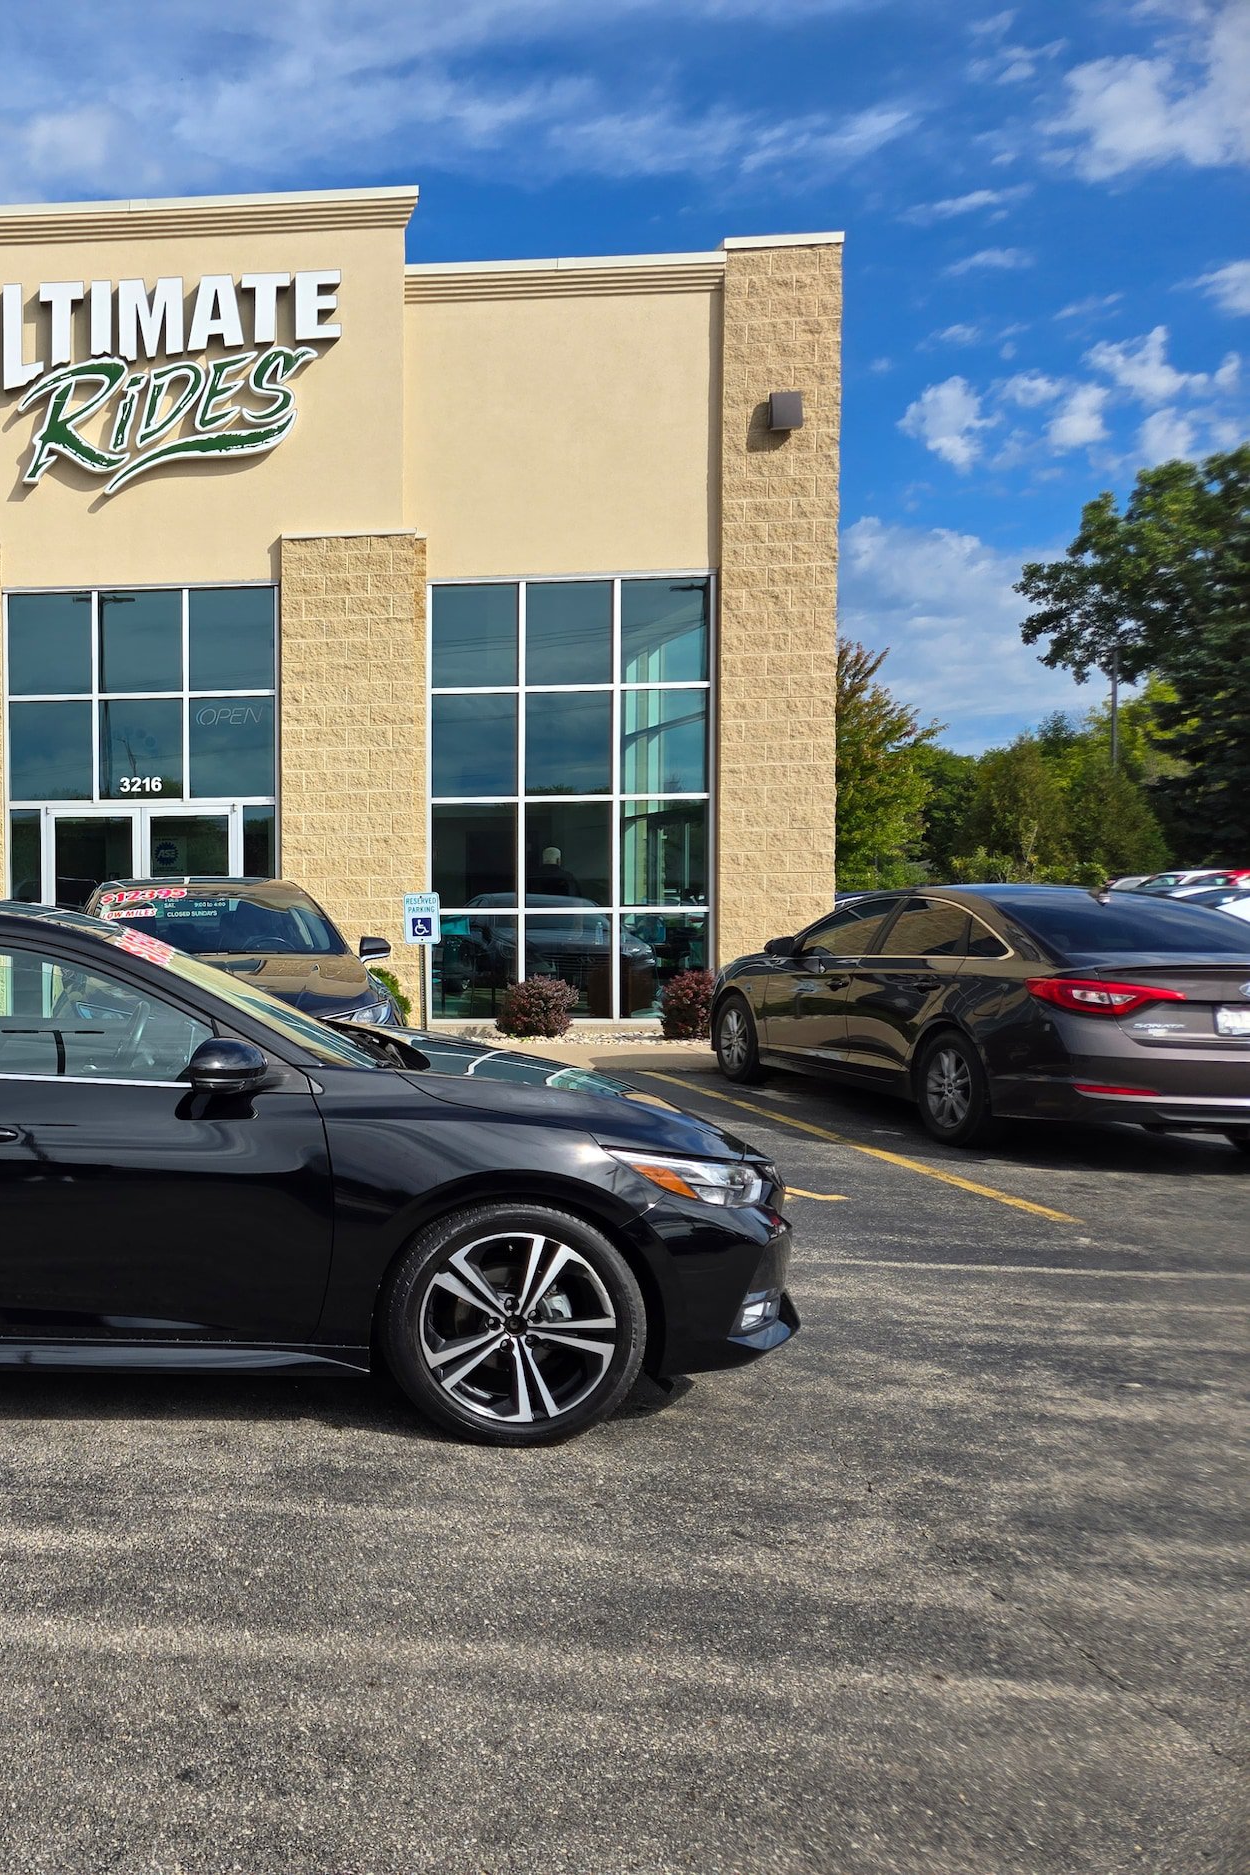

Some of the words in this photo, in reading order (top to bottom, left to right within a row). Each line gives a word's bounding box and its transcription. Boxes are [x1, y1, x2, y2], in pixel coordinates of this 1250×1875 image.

[199, 706, 263, 726] OPEN
[119, 776, 163, 793] 3216
[100, 888, 188, 905] $12395
[125, 909, 157, 918] MILES
